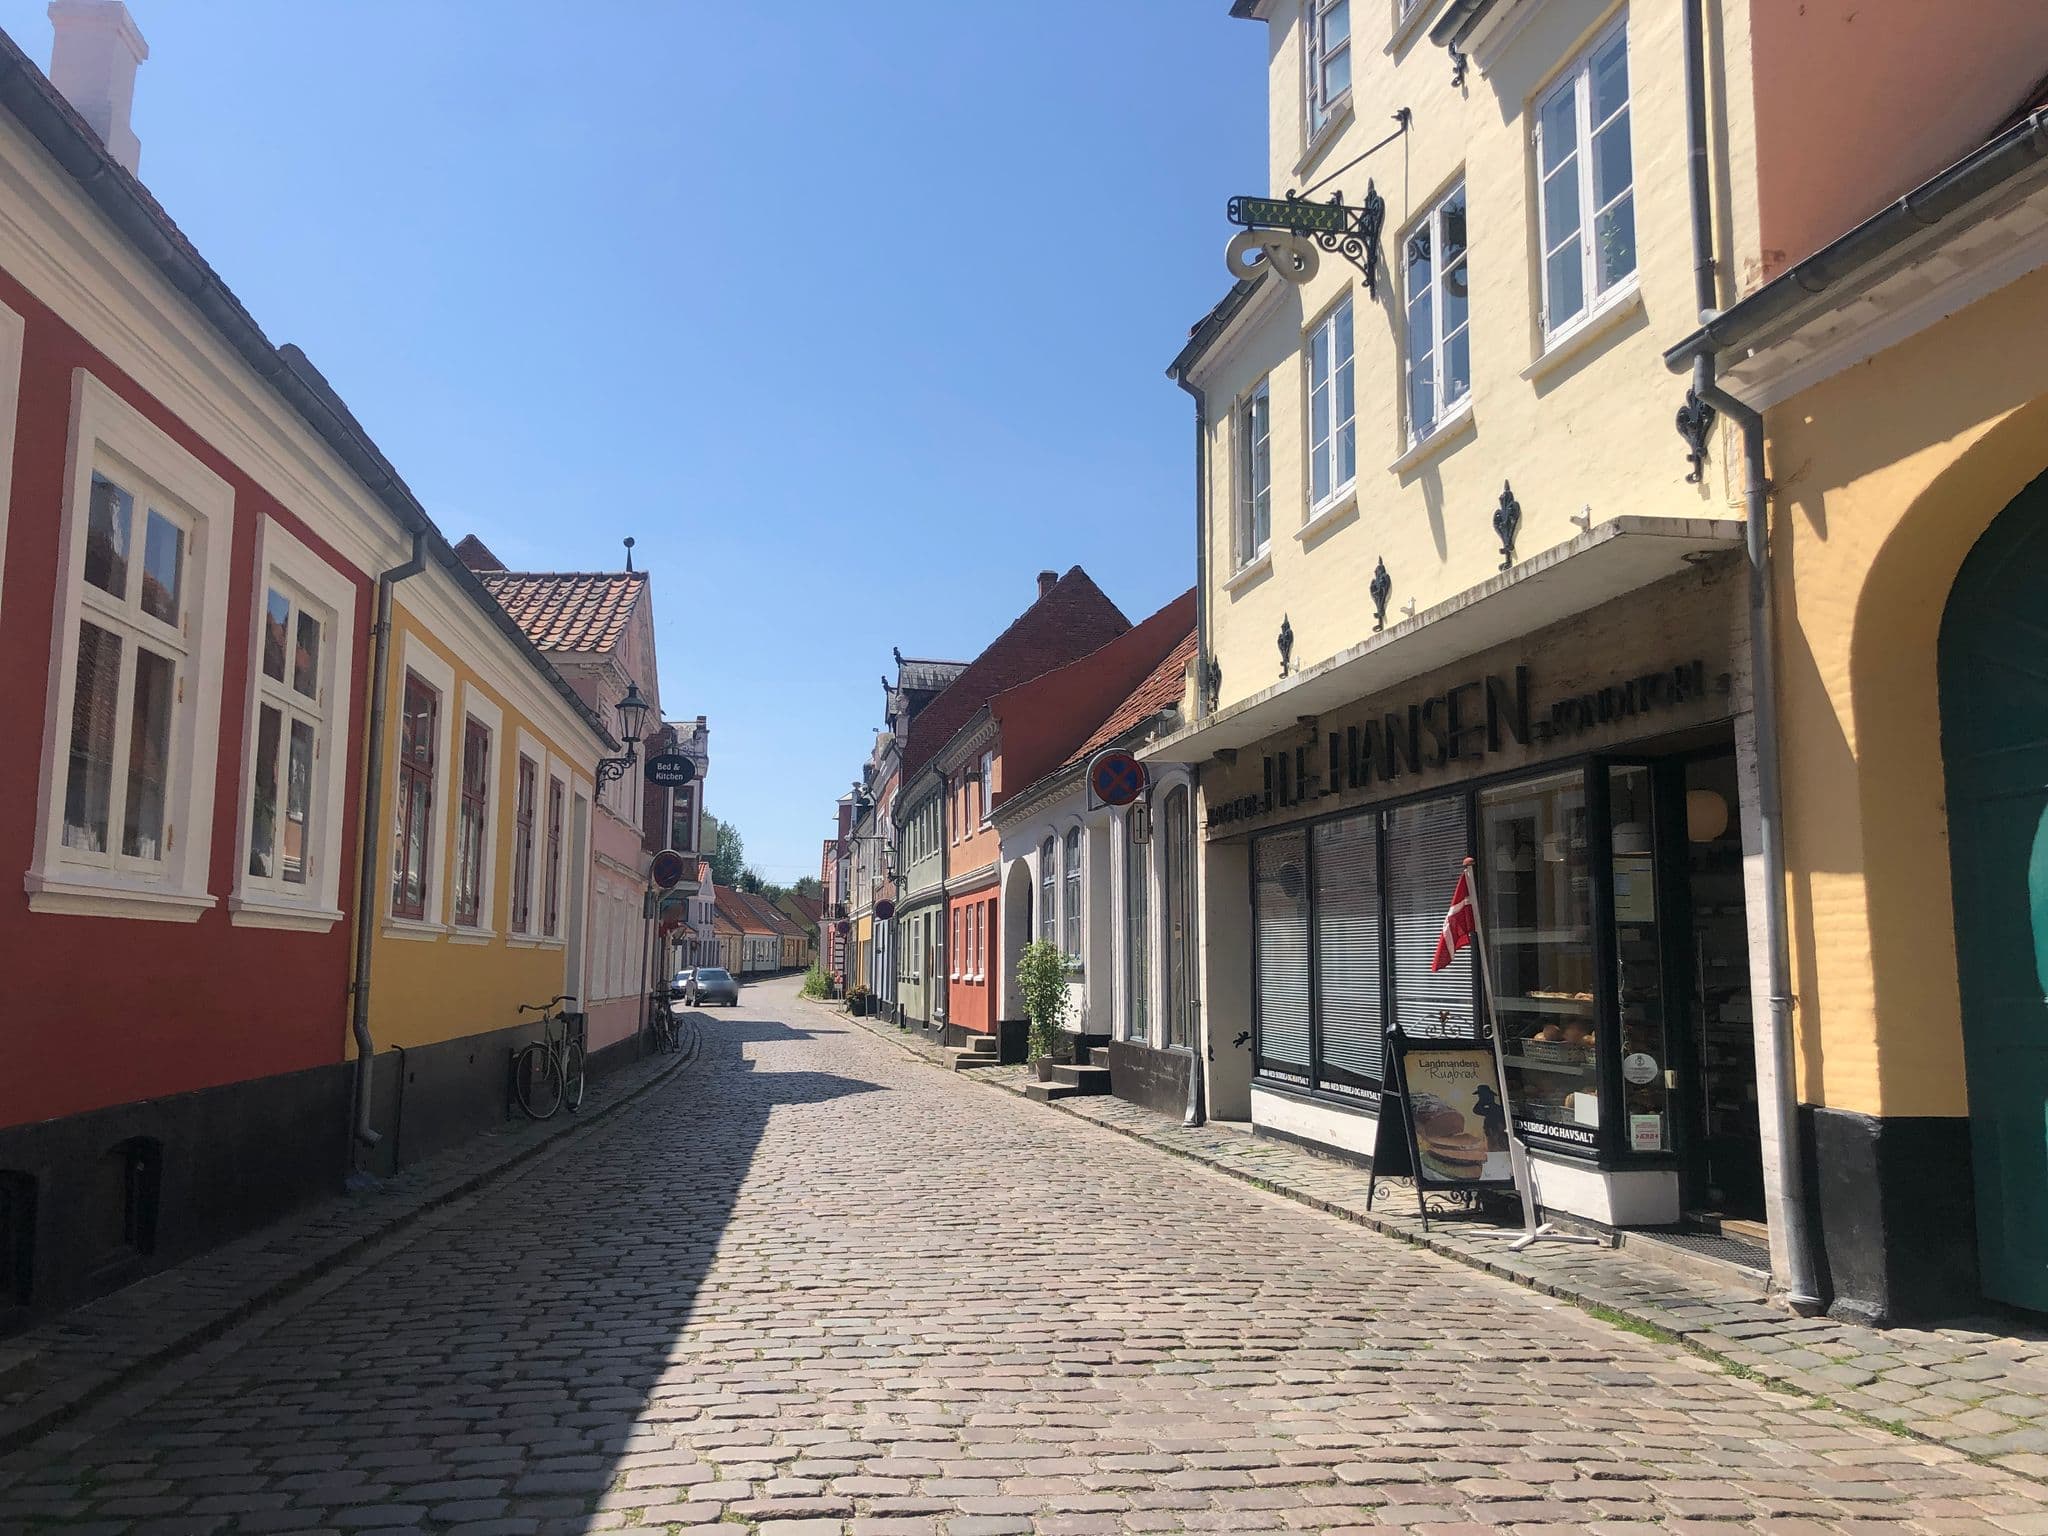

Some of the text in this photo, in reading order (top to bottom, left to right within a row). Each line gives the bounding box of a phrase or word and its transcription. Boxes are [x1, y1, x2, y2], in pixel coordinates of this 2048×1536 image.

[1329, 664, 1530, 793] HANSEN
[673, 763, 680, 771] &
[656, 772, 684, 780] Kitchen
[1418, 1059, 1480, 1068] Landmandens
[1523, 1121, 1548, 1135] SURDEJ
[1548, 1126, 1560, 1137] OG
[1559, 1128, 1594, 1144] HAVSALT
